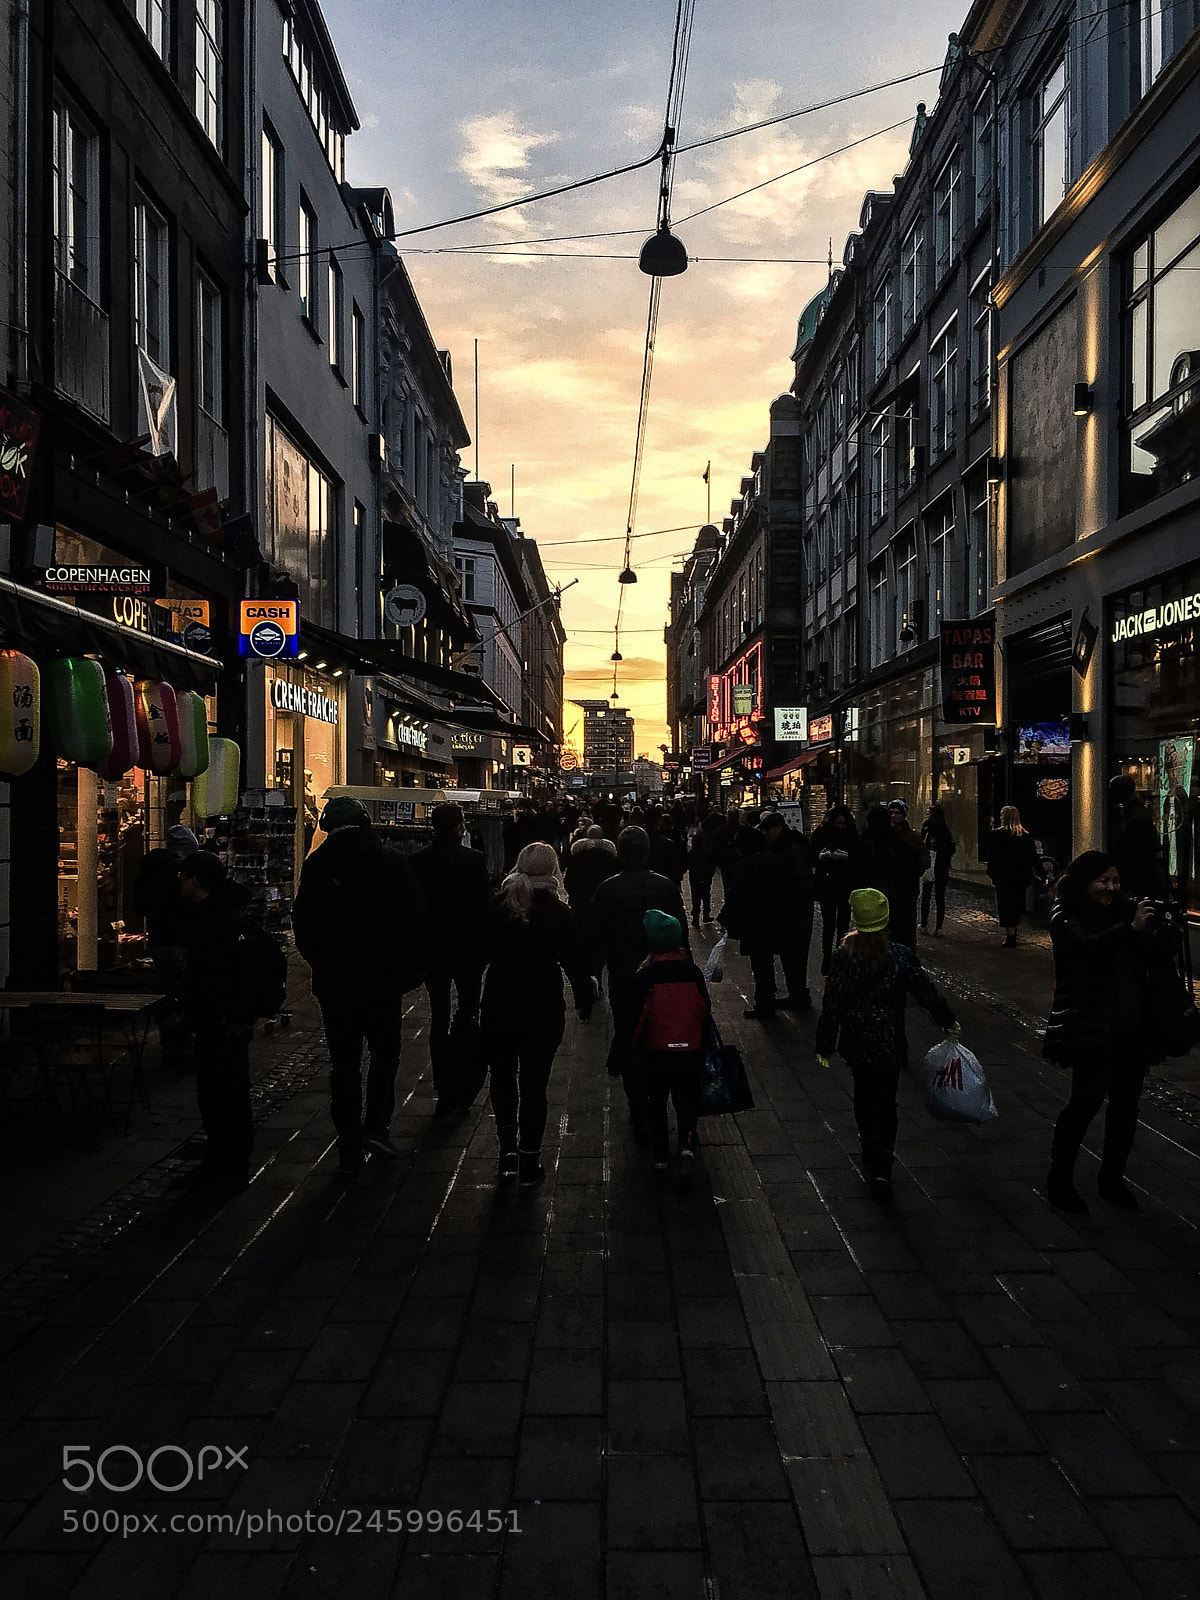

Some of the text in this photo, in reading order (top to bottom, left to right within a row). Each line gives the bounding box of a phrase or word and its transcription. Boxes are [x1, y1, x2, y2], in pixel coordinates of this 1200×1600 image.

[45, 567, 150, 582] COPENHAGEN
[45, 582, 150, 594] souvenir & design
[246, 607, 290, 618] CASH
[1112, 593, 1200, 643] JACK JONES
[942, 628, 992, 645] TAPAS
[952, 653, 984, 669] BAR
[275, 679, 307, 714] CREME
[711, 676, 720, 722] BEIJING
[959, 706, 981, 716] KTV
[399, 801, 411, 812] 49
